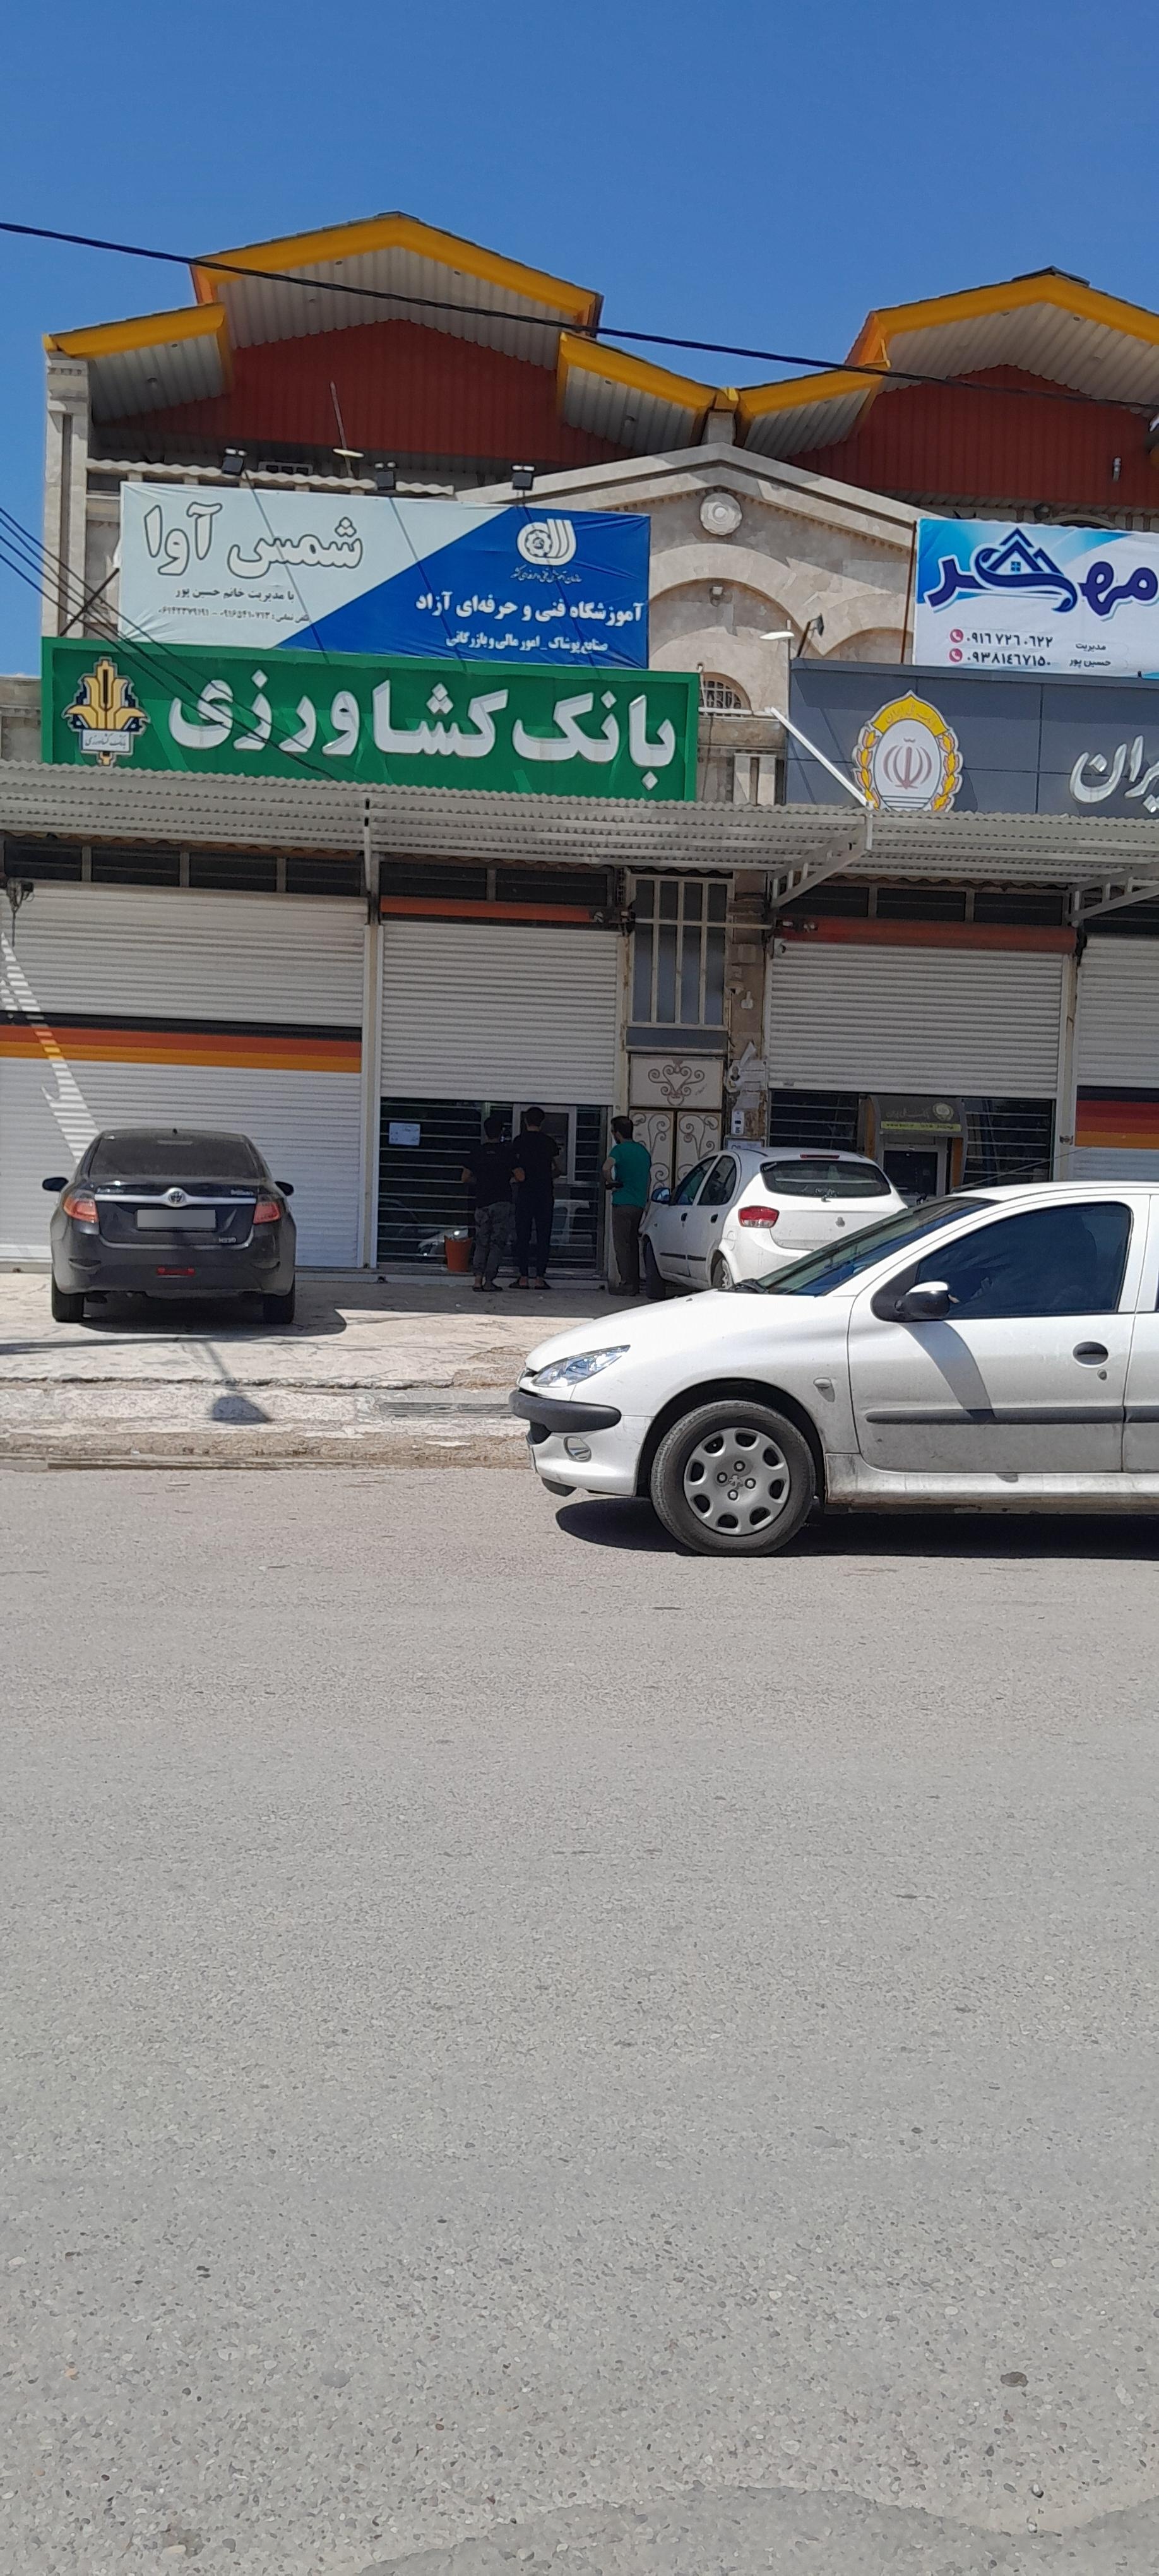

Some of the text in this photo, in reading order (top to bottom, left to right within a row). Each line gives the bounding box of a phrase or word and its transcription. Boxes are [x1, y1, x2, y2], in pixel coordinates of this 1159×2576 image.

[143, 501, 364, 580] شمس آوا
[175, 588, 295, 603] با مدیریت خانم حسین پور
[415, 590, 453, 616] آزاد
[522, 605, 532, 621] و
[535, 598, 566, 622] فنی
[569, 601, 645, 626] آموزشگاه
[495, 633, 519, 650] مالی
[519, 635, 540, 652] امور
[548, 635, 581, 653] پوشاک
[1075, 642, 1107, 653] مدیریت
[1069, 658, 1112, 669] حسین پور
[167, 667, 677, 792] بانک کشاورزی
[1069, 734, 1159, 814] ران
